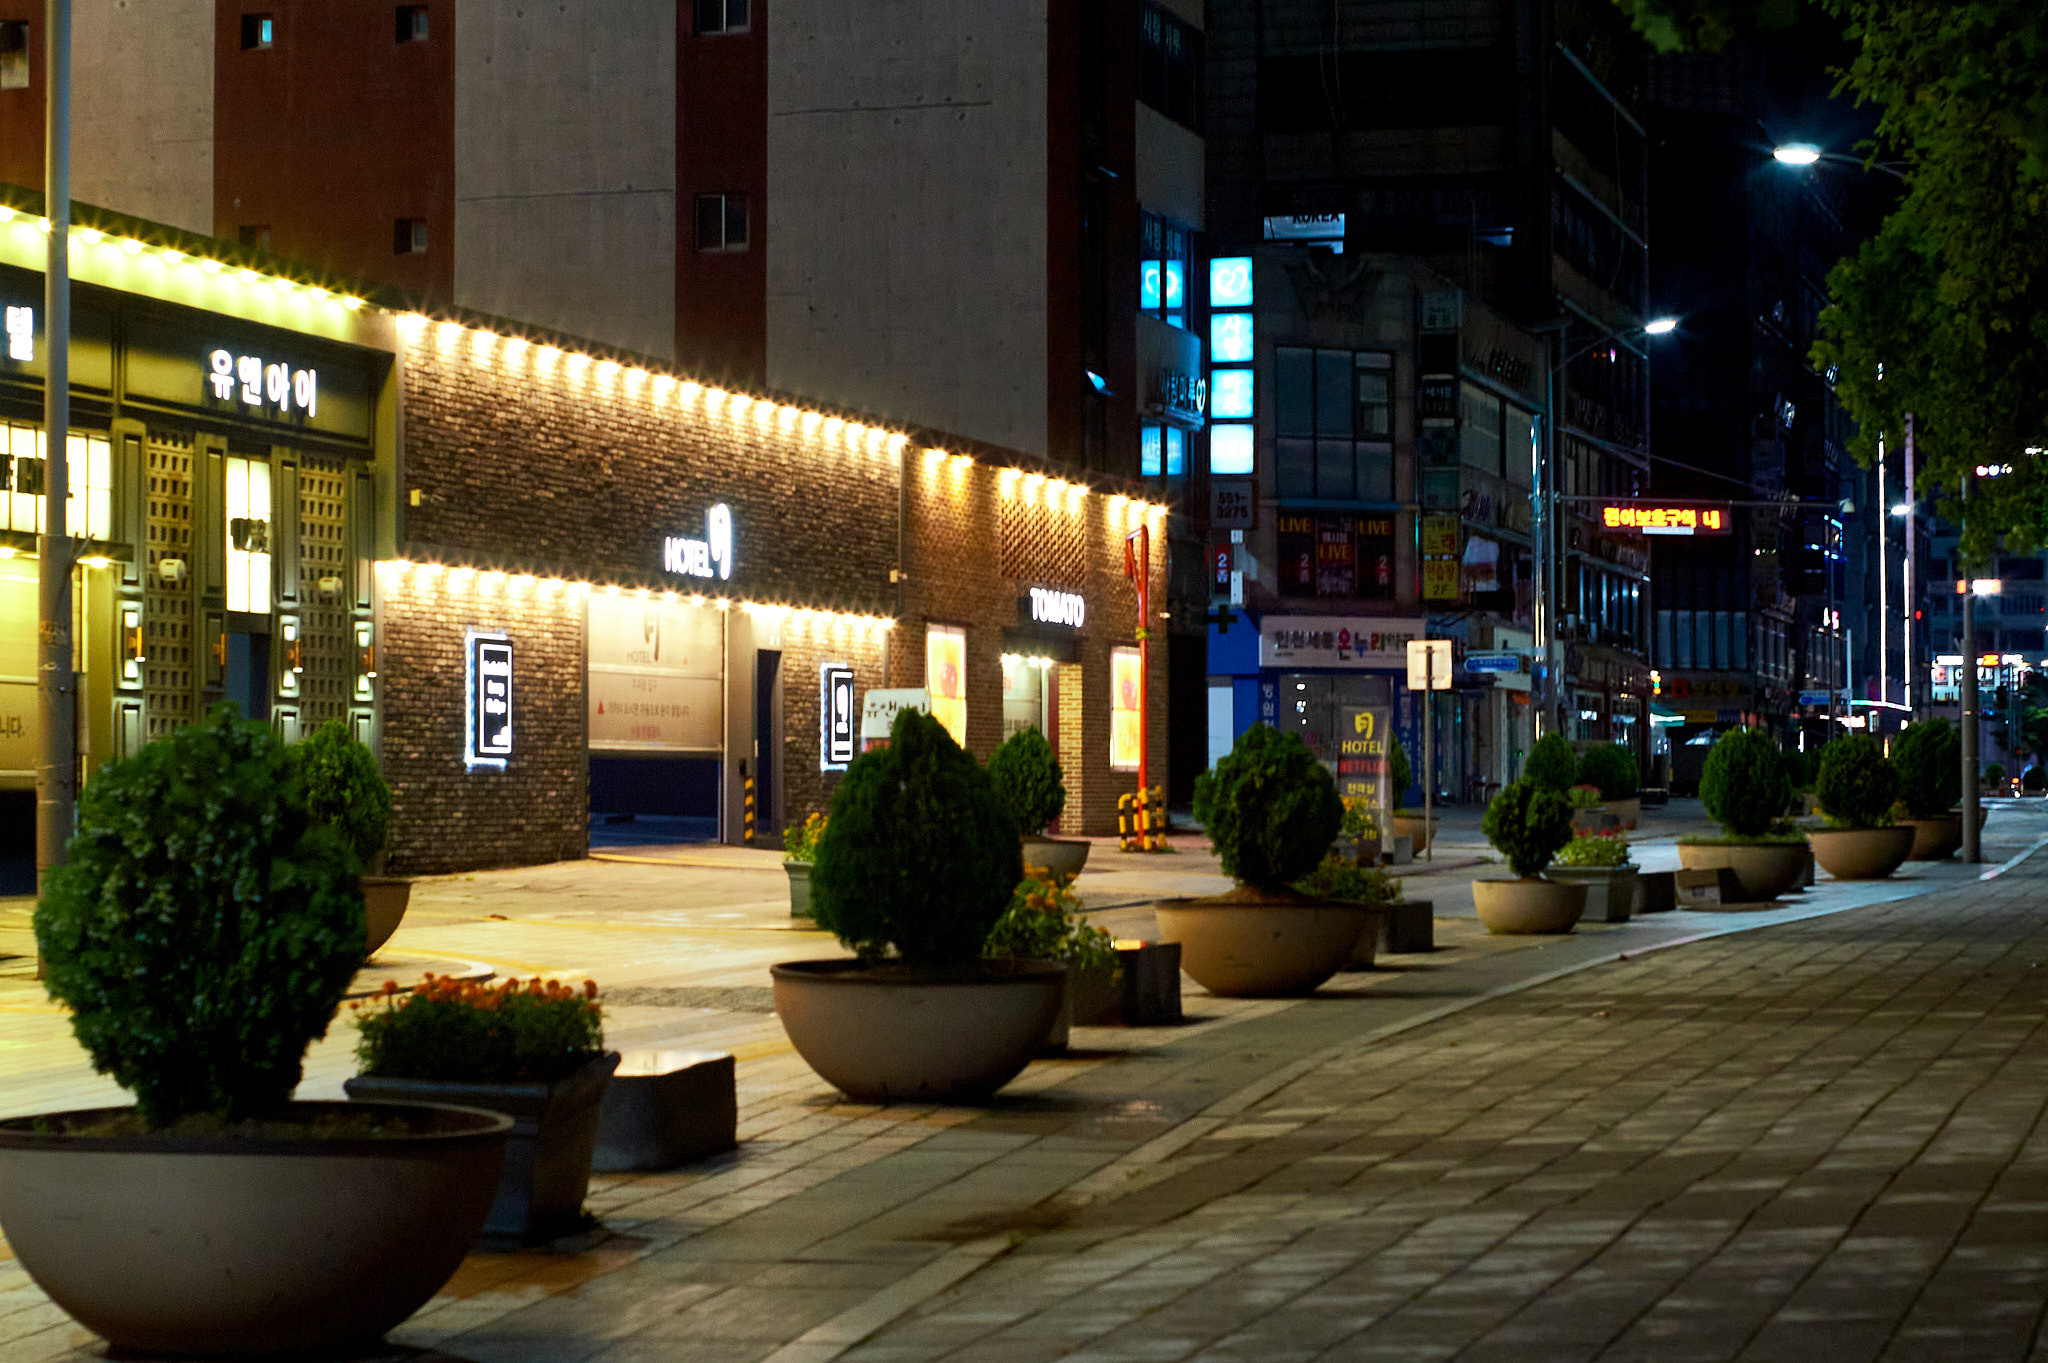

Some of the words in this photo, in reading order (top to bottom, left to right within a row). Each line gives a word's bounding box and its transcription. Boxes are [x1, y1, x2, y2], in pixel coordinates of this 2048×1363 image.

[210, 349, 316, 417] 유앤아이
[1280, 517, 1312, 533] LIVE
[1702, 509, 1720, 529] 내
[1359, 520, 1392, 535] LIVE
[665, 536, 714, 577] HOTEL
[1319, 544, 1352, 560] LIVE
[1433, 584, 1450, 596] 2F
[1030, 587, 1085, 628] TOMATO
[1341, 740, 1384, 753] HOTEL
